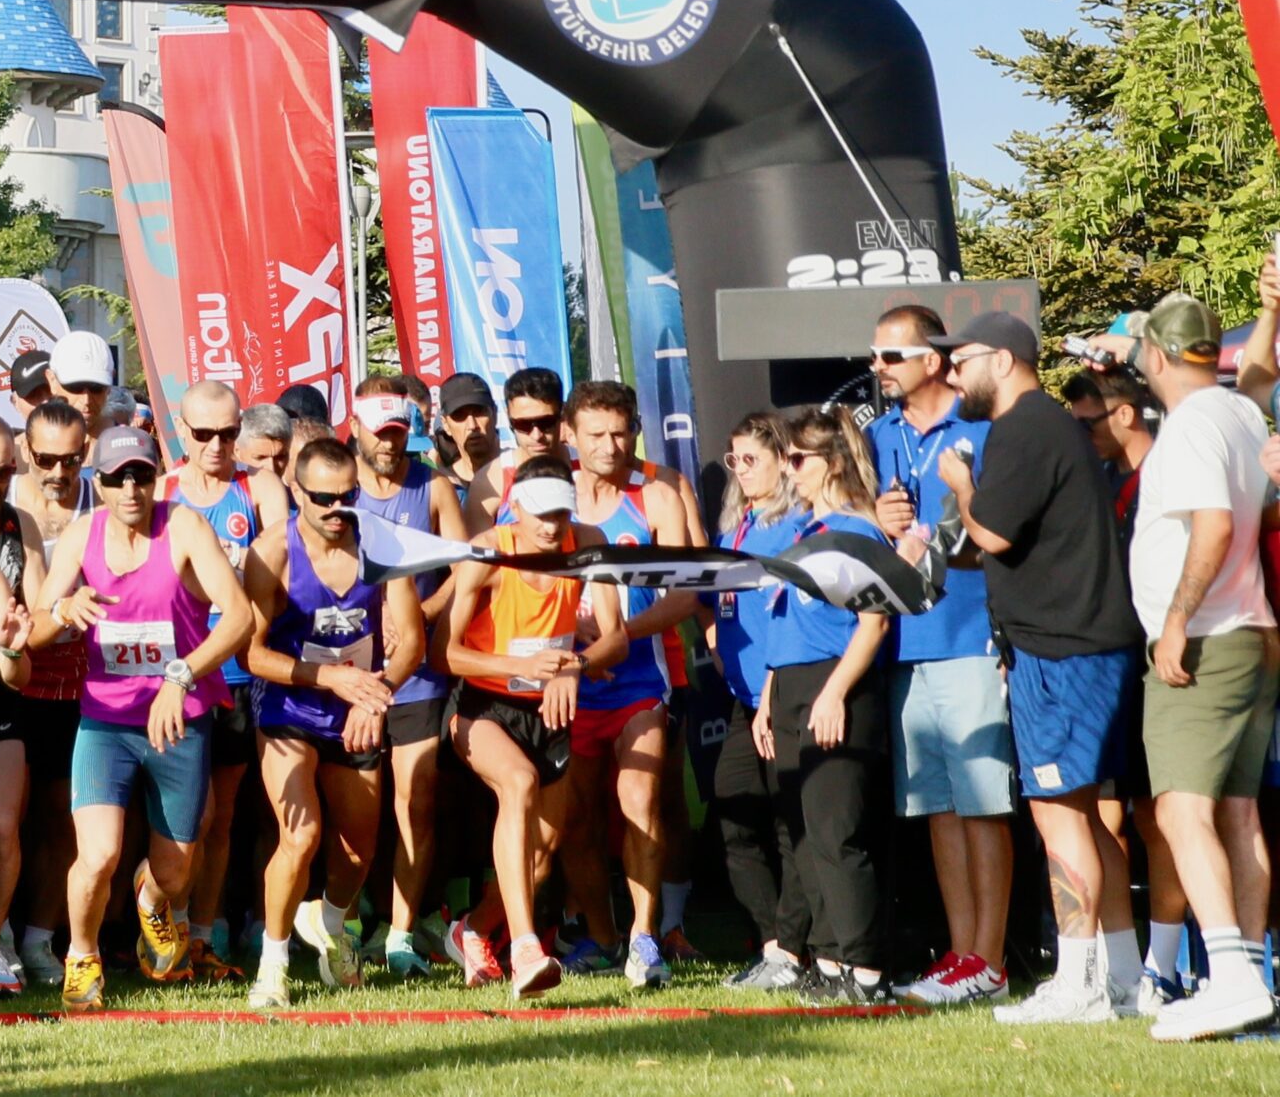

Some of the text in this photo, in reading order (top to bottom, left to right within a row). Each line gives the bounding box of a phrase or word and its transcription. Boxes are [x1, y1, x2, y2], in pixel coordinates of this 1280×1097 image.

[855, 219, 938, 250] EVENT
[786, 248, 942, 289] 2:23
[113, 641, 162, 665] 215
